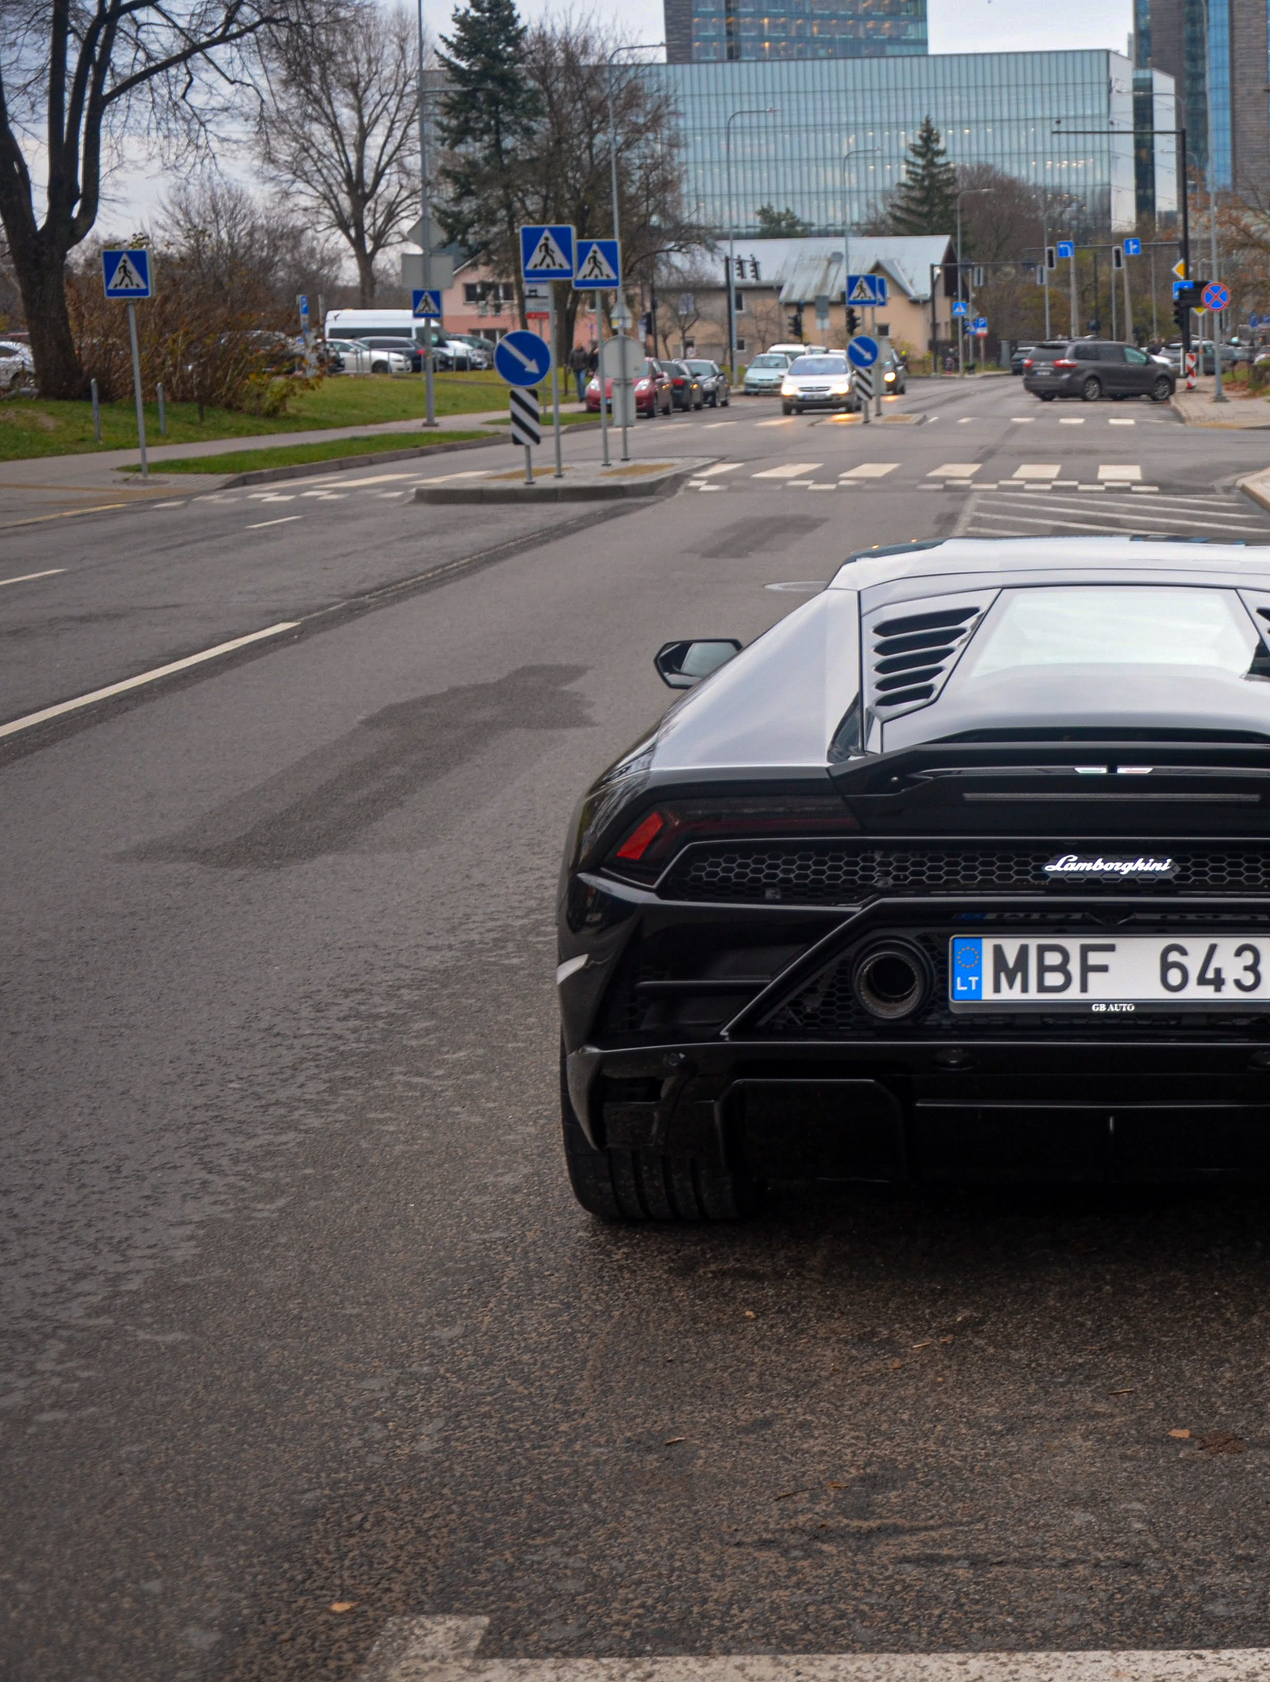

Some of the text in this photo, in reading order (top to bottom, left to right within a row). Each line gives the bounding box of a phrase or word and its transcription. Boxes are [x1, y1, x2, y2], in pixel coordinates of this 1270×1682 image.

[1044, 854, 1172, 875] Lamborghini
[992, 943, 1262, 994] MBF 643
[956, 976, 979, 991] LT
[1091, 1002, 1136, 1013] GB AUTO
